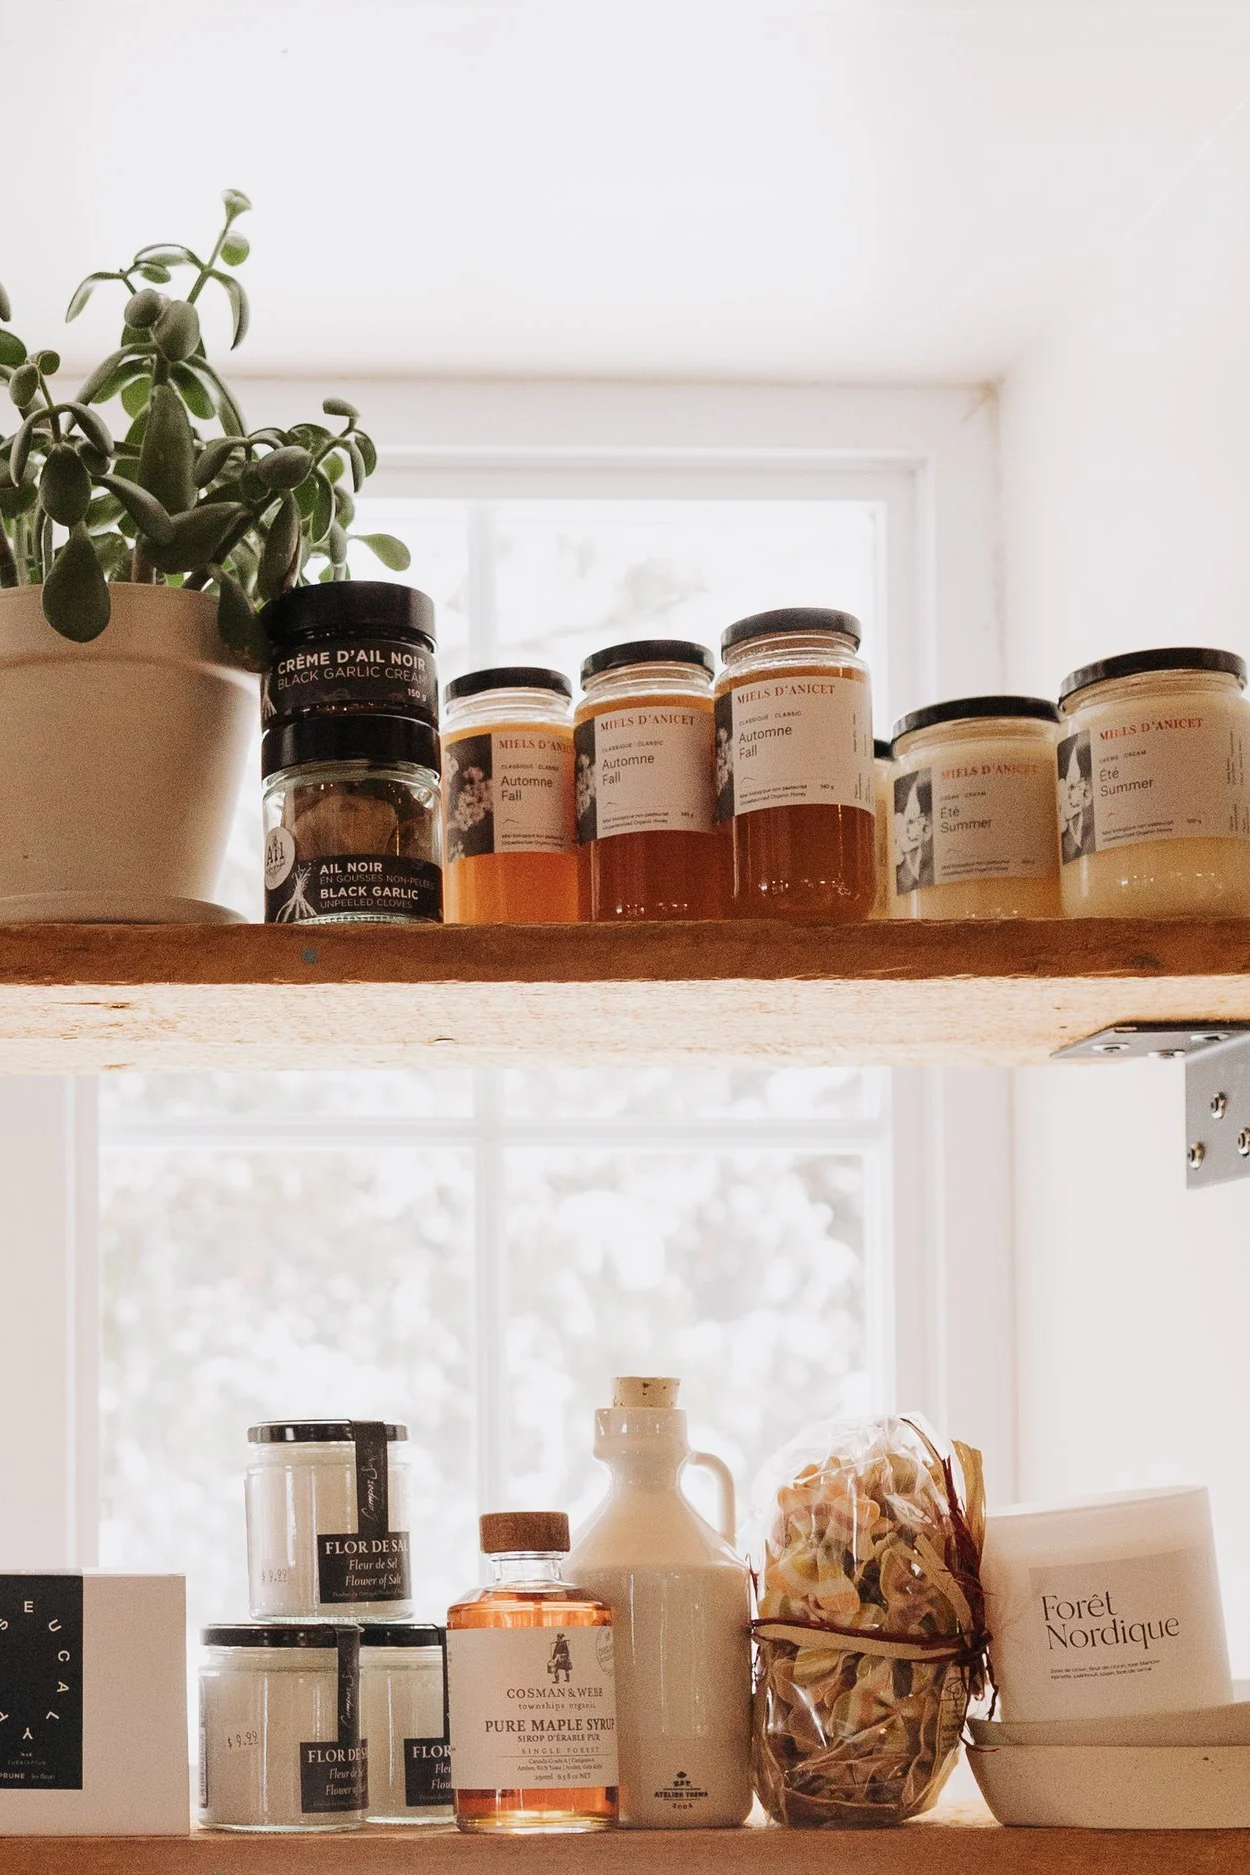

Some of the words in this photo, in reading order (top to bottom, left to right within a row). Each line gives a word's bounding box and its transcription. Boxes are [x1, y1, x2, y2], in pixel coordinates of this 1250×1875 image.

[277, 652, 330, 675] CRÈME
[337, 650, 385, 664] D'AIL
[391, 652, 426, 671] NOIR
[278, 670, 319, 691] BLACK
[323, 666, 381, 680] GARLIC
[385, 668, 427, 683] CREAM
[407, 688, 421, 699] 150
[737, 690, 771, 705] MIELS
[775, 684, 836, 697] D'ANICET
[600, 718, 635, 731] MIELS
[638, 714, 695, 726] D'ANICET
[1100, 723, 1137, 741] MIELS
[1141, 717, 1204, 733] D'ANICET
[738, 725, 792, 744] Automne
[499, 739, 535, 750] MIELS
[739, 744, 757, 760] Fall
[602, 754, 655, 771] Automne
[602, 772, 621, 785] Fall
[1100, 766, 1119, 782] Été
[501, 776, 554, 788] Automne
[1100, 778, 1154, 797] Summer
[501, 790, 522, 801] Fall
[940, 818, 992, 833] Summer
[320, 864, 343, 875] AIL
[347, 862, 383, 873] NOIR
[320, 876, 333, 884] EN
[337, 874, 384, 883] GOUSSES
[320, 886, 367, 899] BLACK
[372, 886, 419, 900] GARLIC
[320, 898, 374, 909] UNPEELED
[377, 898, 413, 909] CLOVES
[325, 1540, 368, 1555] FLOR
[372, 1539, 390, 1552] DE
[391, 1539, 408, 1552] SAL
[349, 1559, 374, 1571] Fleur
[375, 1558, 386, 1569] de
[387, 1557, 398, 1569] Sel
[345, 1575, 376, 1587] Flower
[378, 1574, 387, 1589] of
[1041, 1591, 1118, 1621] Forêt
[1046, 1617, 1180, 1650] Nordique
[506, 1687, 566, 1699] COSMAN
[569, 1688, 576, 1698] &
[577, 1687, 603, 1698] WEBB
[519, 1701, 565, 1712] townships
[569, 1701, 596, 1711] organic
[485, 1720, 526, 1732] PURE
[531, 1719, 583, 1732] MAPLE
[586, 1718, 615, 1731] SYRUP
[518, 1735, 545, 1743] SIROP
[547, 1733, 585, 1742] D'ÉRABLE
[587, 1733, 600, 1742] PUR
[307, 1748, 346, 1763] FLOR
[329, 1768, 350, 1780] Fleur
